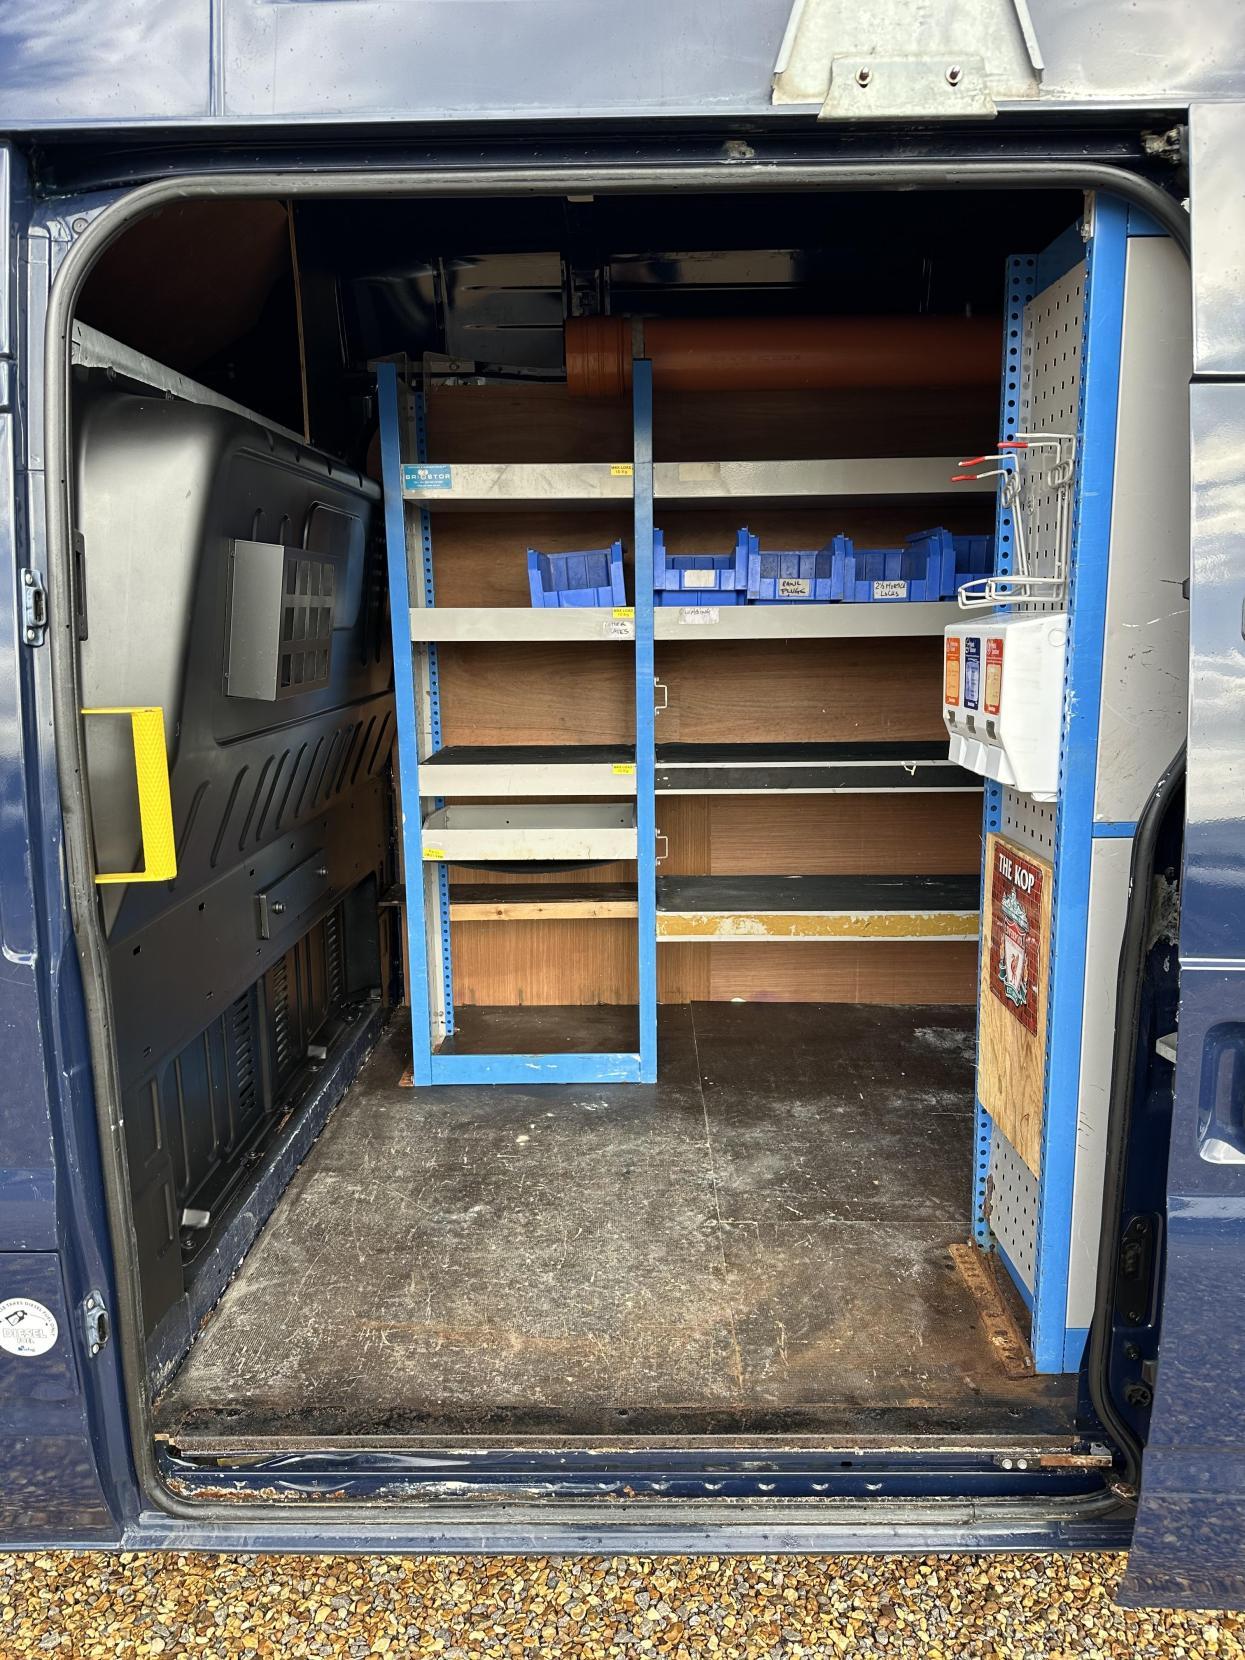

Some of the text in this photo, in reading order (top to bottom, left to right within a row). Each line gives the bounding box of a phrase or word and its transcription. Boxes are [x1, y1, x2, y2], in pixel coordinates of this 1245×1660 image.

[999, 852, 1035, 894] THE KOP
[2, 1328, 48, 1338] DIESEL
